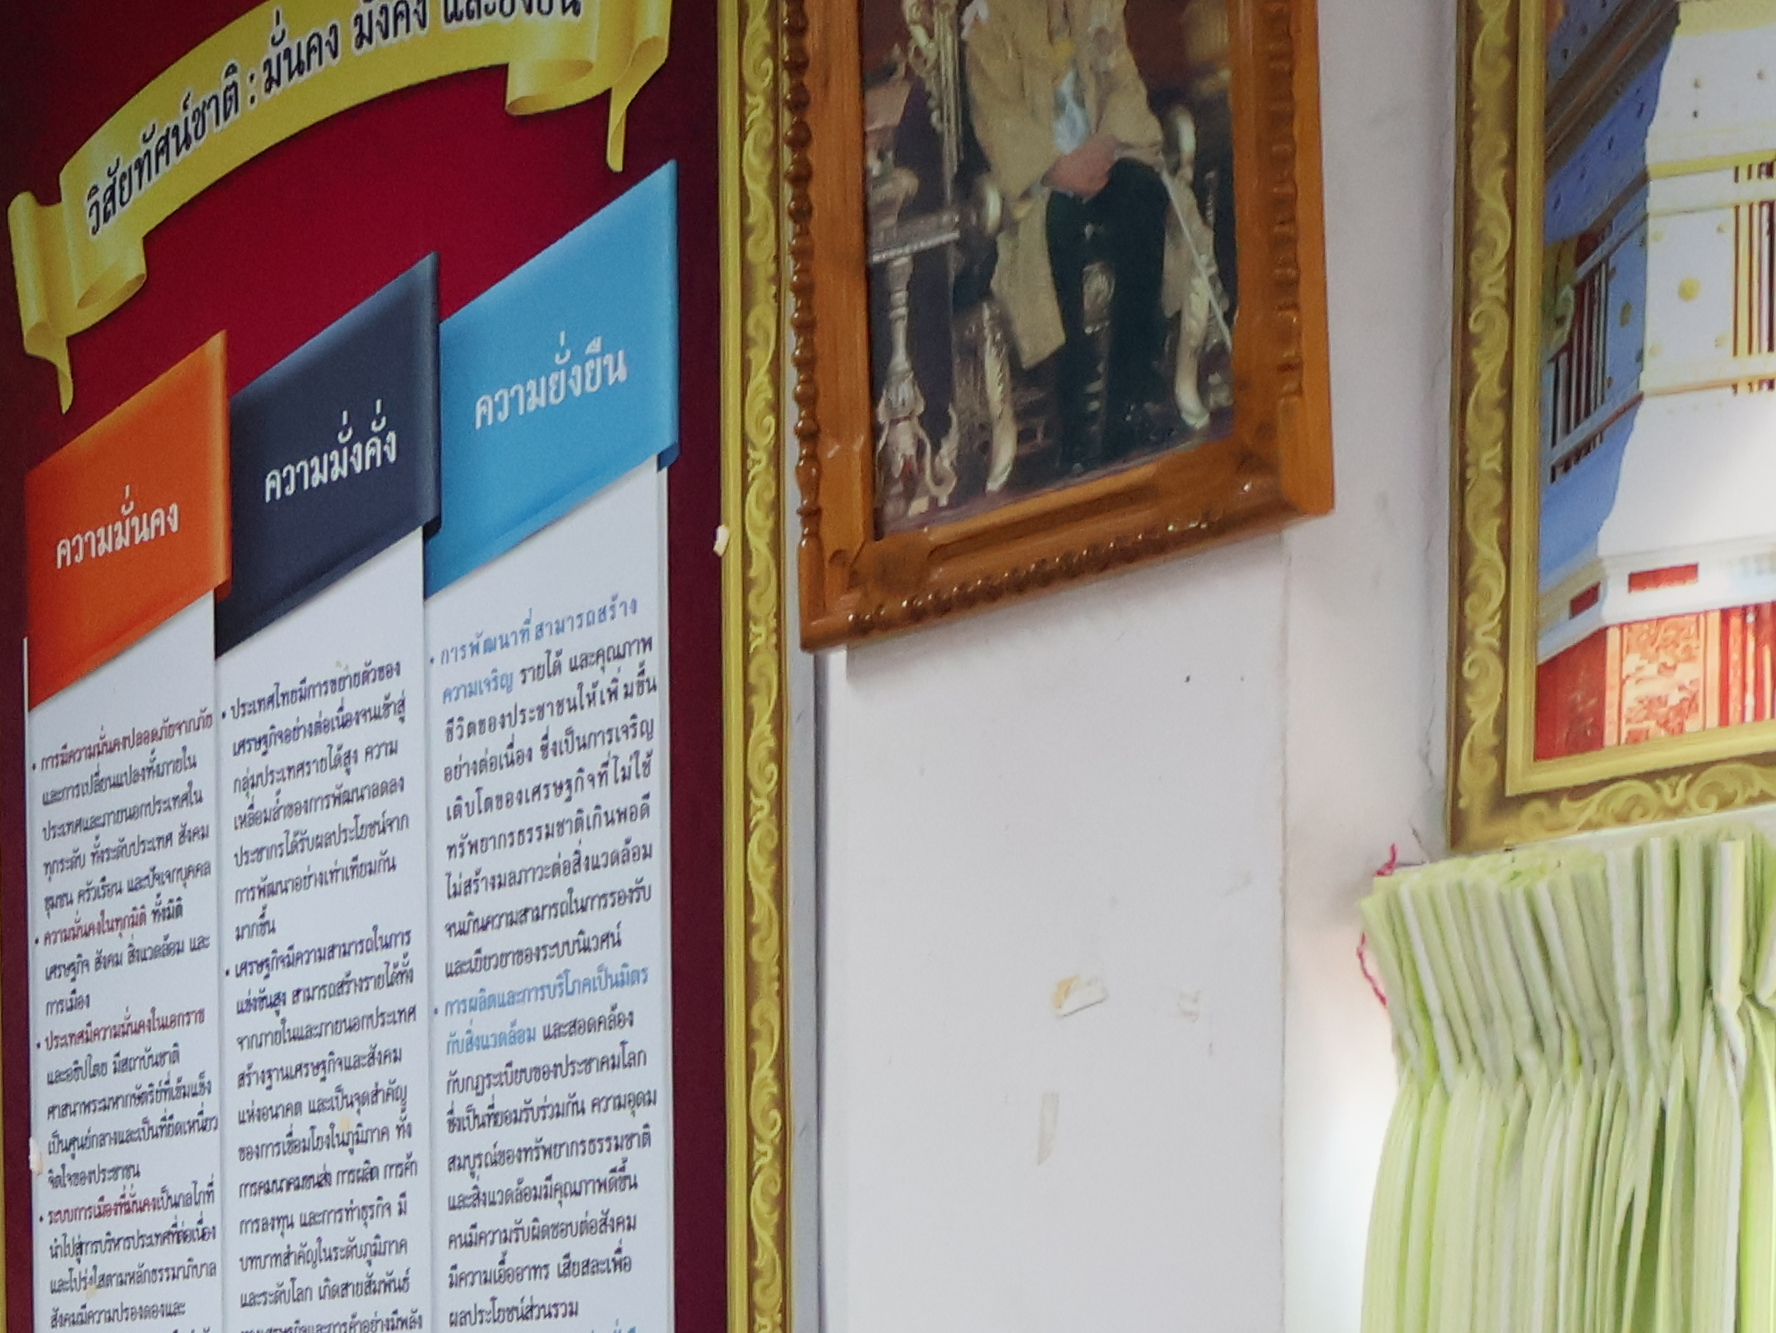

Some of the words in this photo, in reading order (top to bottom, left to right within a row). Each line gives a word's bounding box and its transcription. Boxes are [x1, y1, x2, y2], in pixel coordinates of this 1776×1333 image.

[85, 62, 241, 236] วิสัยทัศน์ชาติ
[261, 10, 340, 94] มั่นคง
[474, 331, 629, 430] ความยั่งยืน
[264, 399, 398, 504] ความมั่งคั่ง
[55, 484, 181, 570] ความมั่นคง
[442, 668, 514, 704] ความเจริญ
[519, 648, 563, 685] รายได้
[568, 636, 653, 674] และคุณภาพ
[364, 739, 399, 763] ความ
[443, 733, 533, 783] อย่างต่อเนื่อง
[539, 713, 654, 761] ซึ่งเป็นการเจริญ
[446, 792, 651, 860] ทรัพยากรธรรมชาติเกินพอดี
[42, 847, 86, 883] ทุกระดับ
[177, 822, 210, 846] สังคม
[235, 903, 277, 942] มากขึ้น
[94, 948, 123, 972] สังคม
[189, 935, 211, 953] และ
[542, 1002, 634, 1041] และสอดคล้อง
[395, 1108, 413, 1140] ทั้ง
[590, 1089, 657, 1118] ความอุดม
[239, 1213, 295, 1239] การลงทุน
[397, 1190, 408, 1217] มี
[448, 1208, 637, 1250] คนมีความรับผิดชอบต่อสังคม
[556, 1238, 633, 1279] เสียสละเพื่อ
[240, 1276, 313, 1309] และระดับโลก
[448, 1295, 579, 1328] ผลประโยชน์ส่วนรวม
